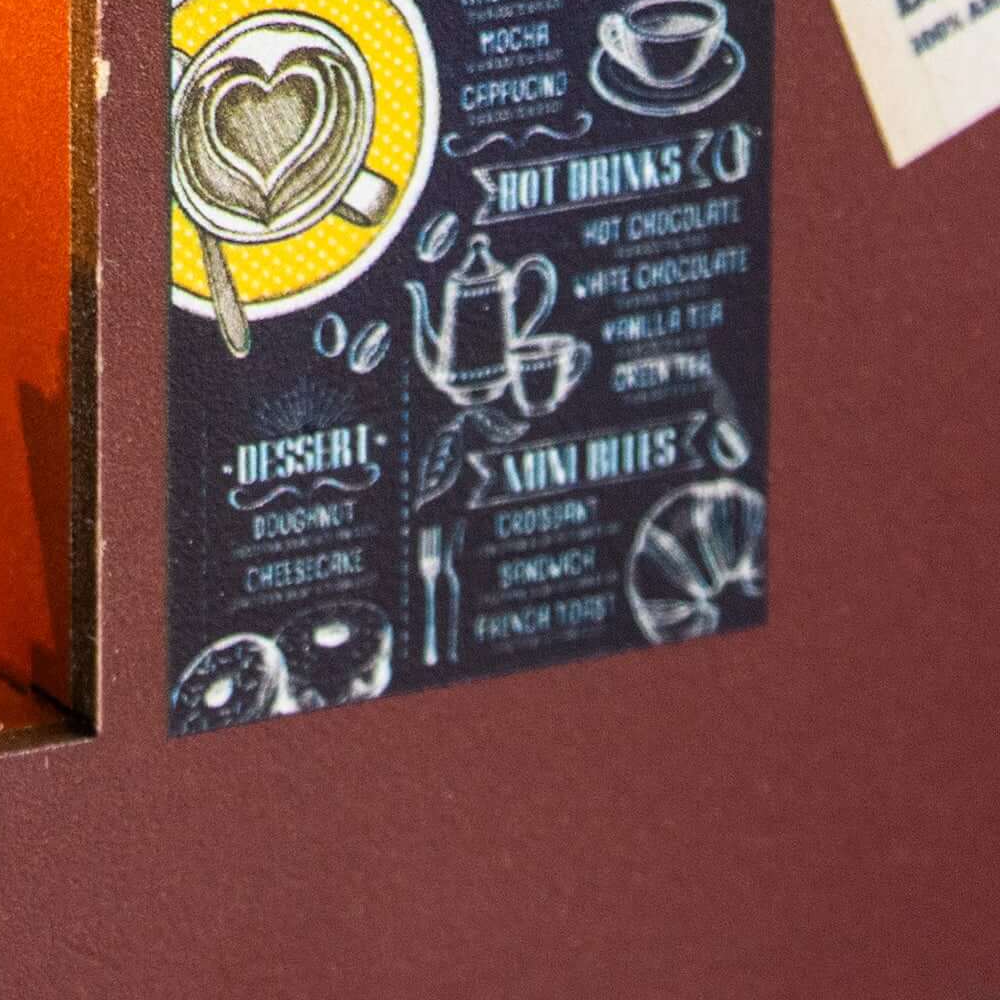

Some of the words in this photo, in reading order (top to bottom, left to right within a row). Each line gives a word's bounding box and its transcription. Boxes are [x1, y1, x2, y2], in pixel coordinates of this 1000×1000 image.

[479, 21, 550, 56] MOCHA
[499, 165, 556, 213] HOT
[567, 144, 683, 202] DRINKS
[581, 215, 622, 247] HOT
[627, 199, 741, 241] CHOCOLATE
[633, 246, 748, 290] CHOCOLATE
[237, 423, 368, 486] DESSERT
[586, 426, 678, 482] BITES
[246, 548, 364, 592] CHEESECAKE
